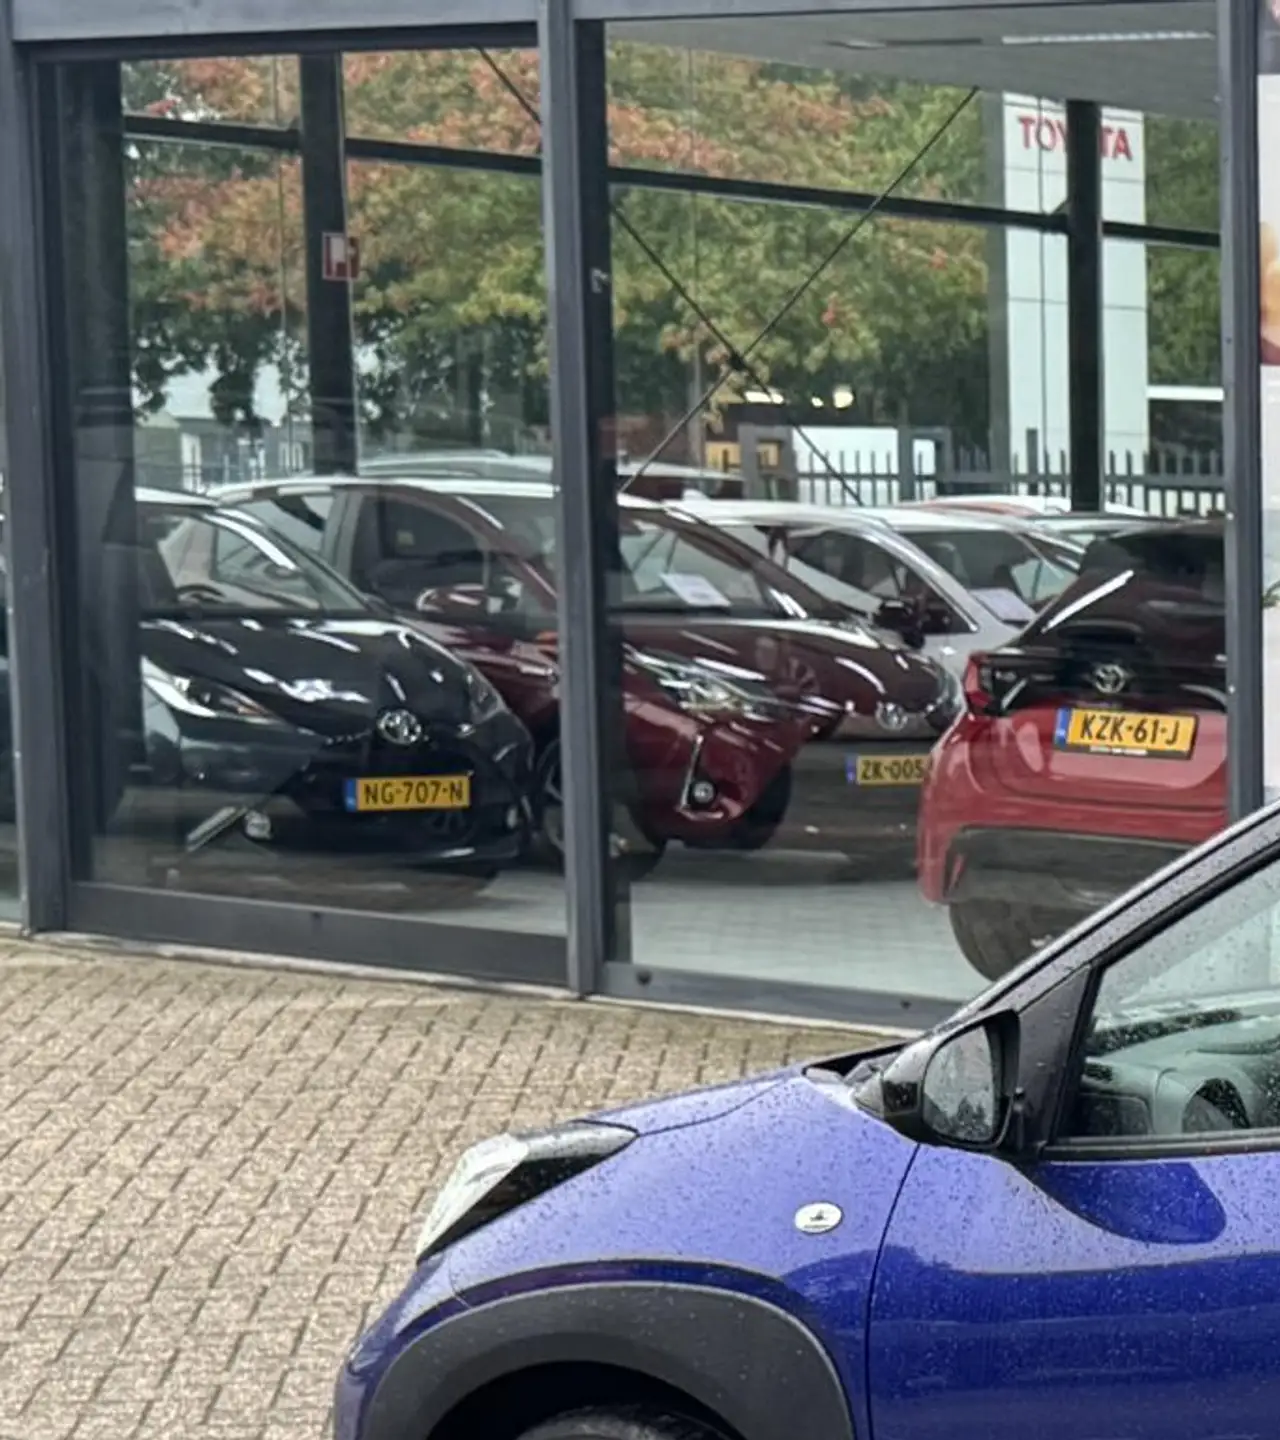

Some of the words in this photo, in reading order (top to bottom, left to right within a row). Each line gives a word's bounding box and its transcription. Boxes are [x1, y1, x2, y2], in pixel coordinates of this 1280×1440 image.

[1018, 115, 1133, 161] TOTA
[1080, 713, 1181, 745] KZK-61-J
[861, 758, 927, 781] ZK-005
[364, 780, 464, 805] NG-707-N
